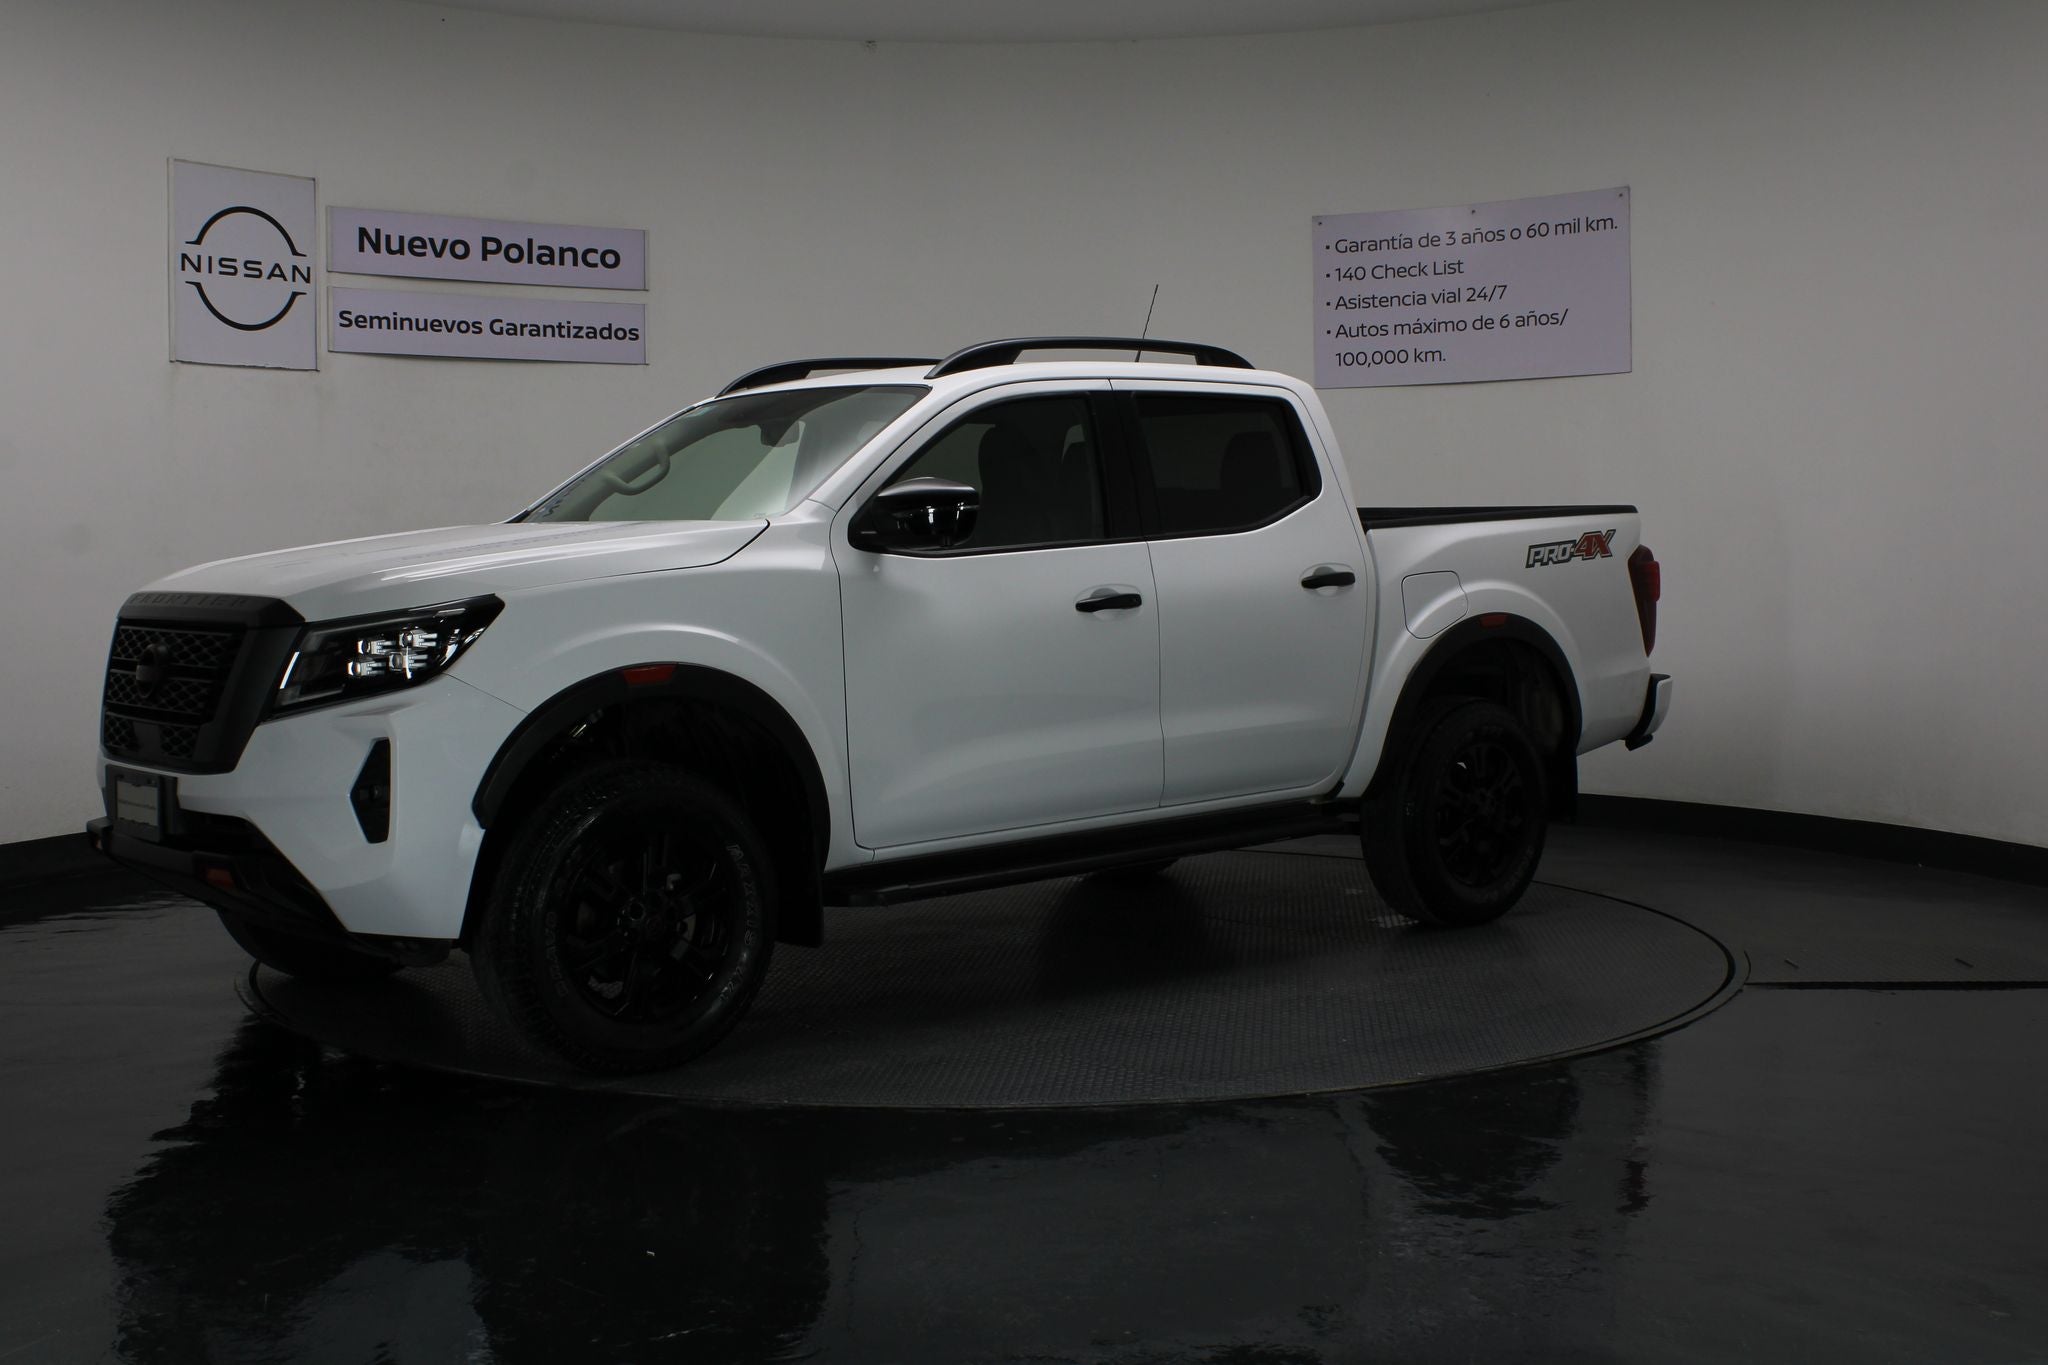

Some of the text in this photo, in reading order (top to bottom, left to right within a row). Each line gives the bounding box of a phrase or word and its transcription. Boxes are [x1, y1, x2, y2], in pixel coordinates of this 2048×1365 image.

[359, 227, 620, 269] Nuevo Polanco
[1335, 217, 1617, 253] Garantía de 3 años o 60 mil km.
[181, 253, 311, 284] NISSAN
[1336, 260, 1464, 281] 140 Check List
[1335, 285, 1507, 310] Asistencia vial 24/7
[339, 310, 639, 341] Seminuevos Garantizados
[1336, 309, 1568, 338] Autos máximo de 6 años/
[1336, 348, 1445, 367] 100,000 km.
[1525, 529, 1616, 568] PRO-4X
